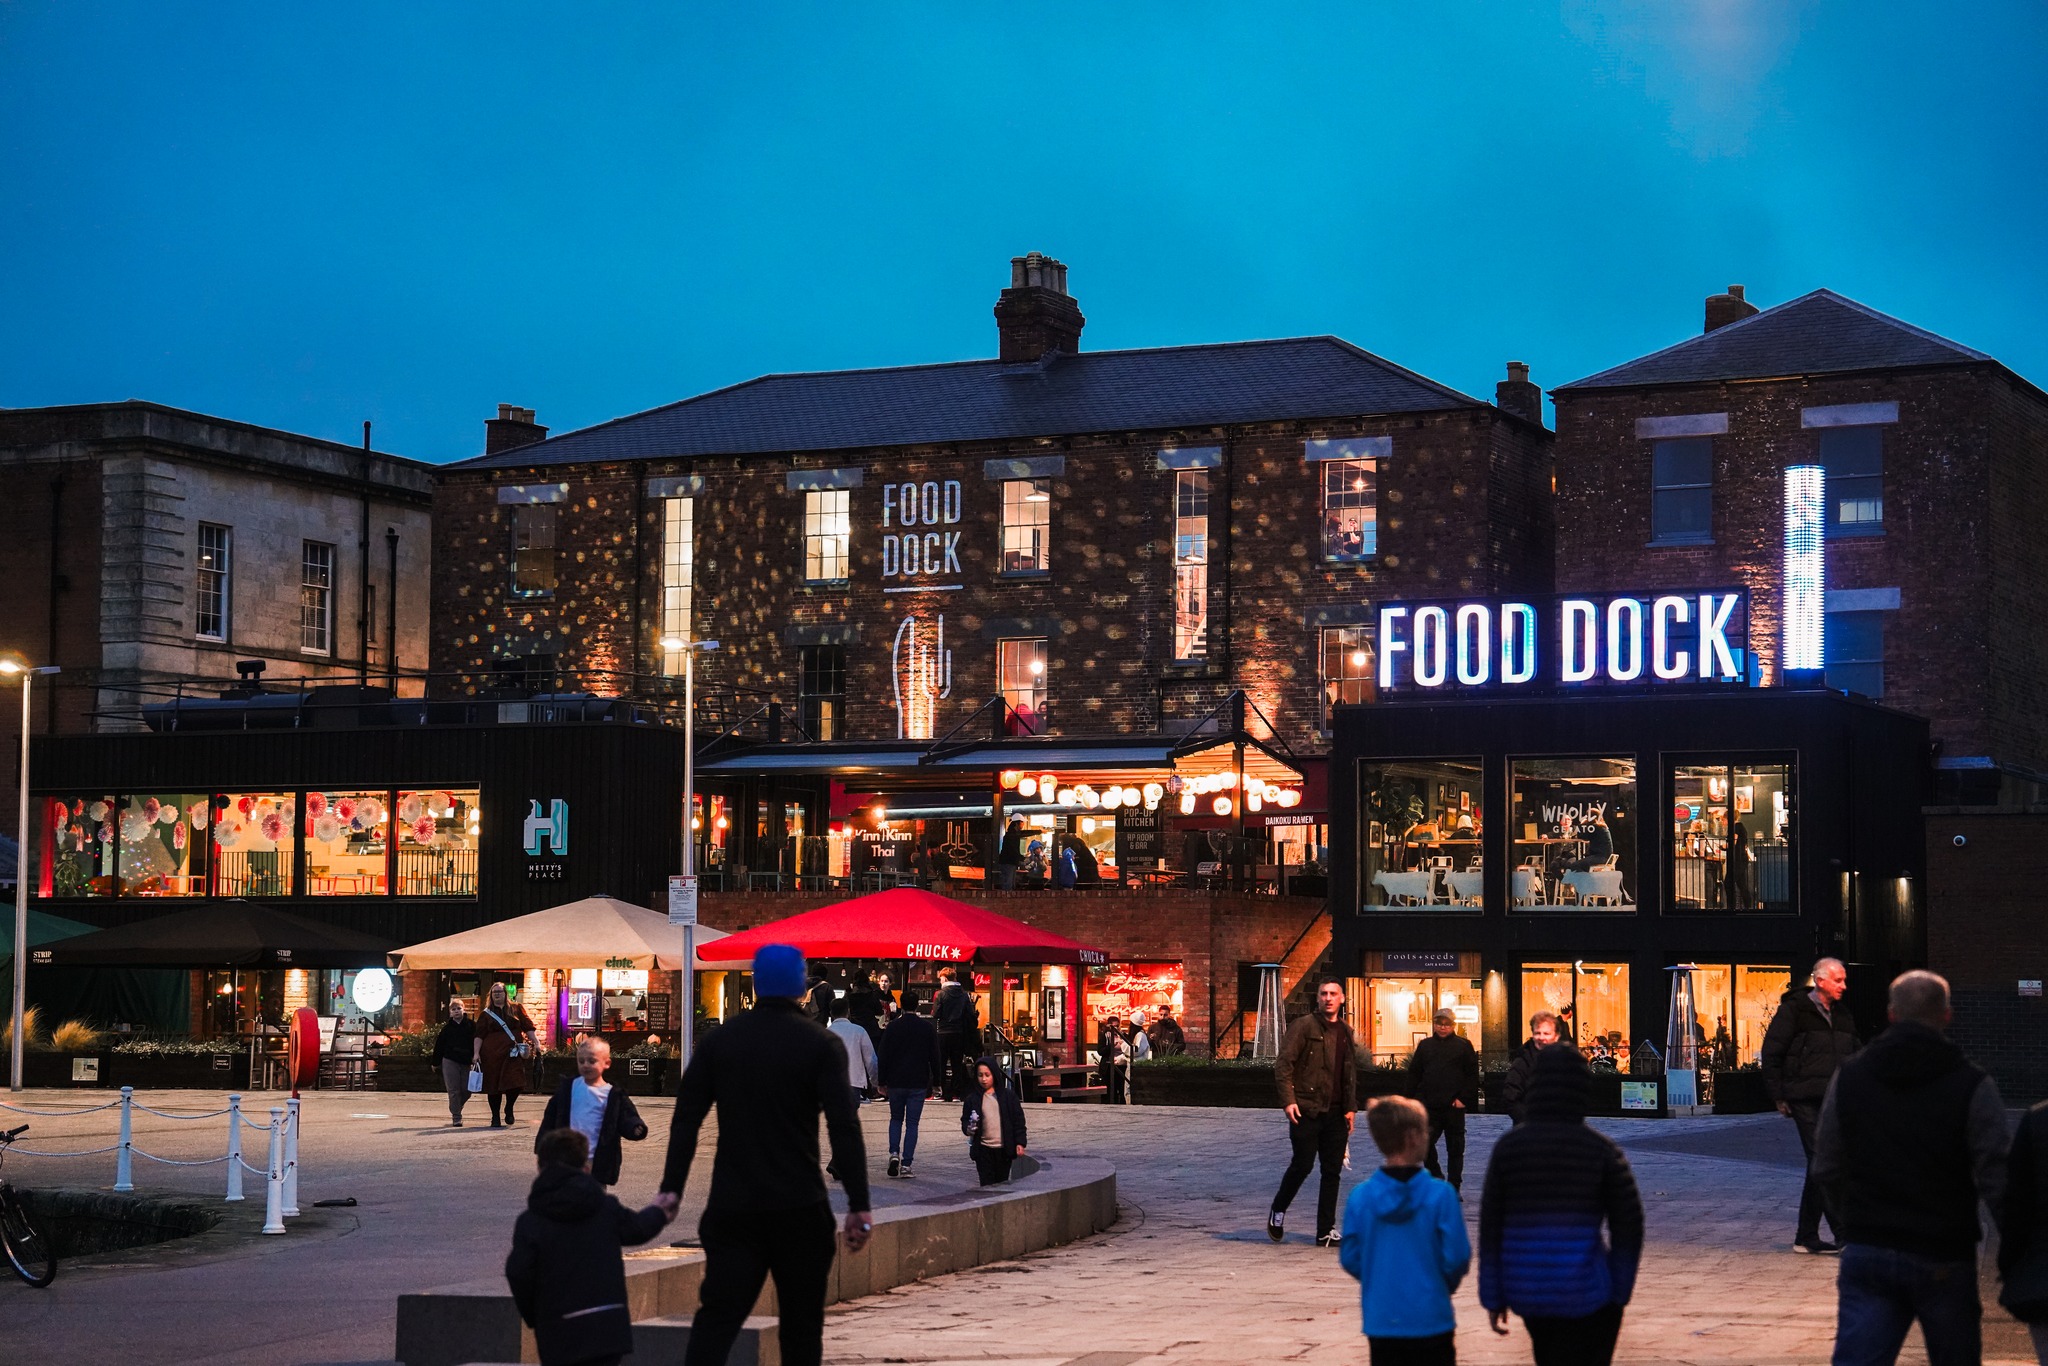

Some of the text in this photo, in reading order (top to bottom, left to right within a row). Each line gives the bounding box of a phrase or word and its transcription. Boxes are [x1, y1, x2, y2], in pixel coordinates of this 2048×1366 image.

[883, 480, 961, 527] FOOD
[883, 531, 961, 576] DOCK
[1379, 594, 1739, 687] FOOD DOCK
[1124, 809, 1154, 818] POP-UP
[1542, 800, 1607, 823] WHOLLY
[1124, 817, 1154, 827] KITCHEN
[1265, 815, 1314, 825] DAIKOKU RAMEN
[886, 829, 912, 841] Kinn
[1552, 825, 1596, 833] GEATO
[1136, 833, 1154, 841] ROOM
[871, 844, 896, 857] Thai
[529, 871, 562, 879] PLACE
[33, 950, 52, 959] STRIP
[906, 943, 950, 959] CHUCK
[1079, 949, 1100, 963] CHUCK
[1106, 975, 1168, 993] Chuck
